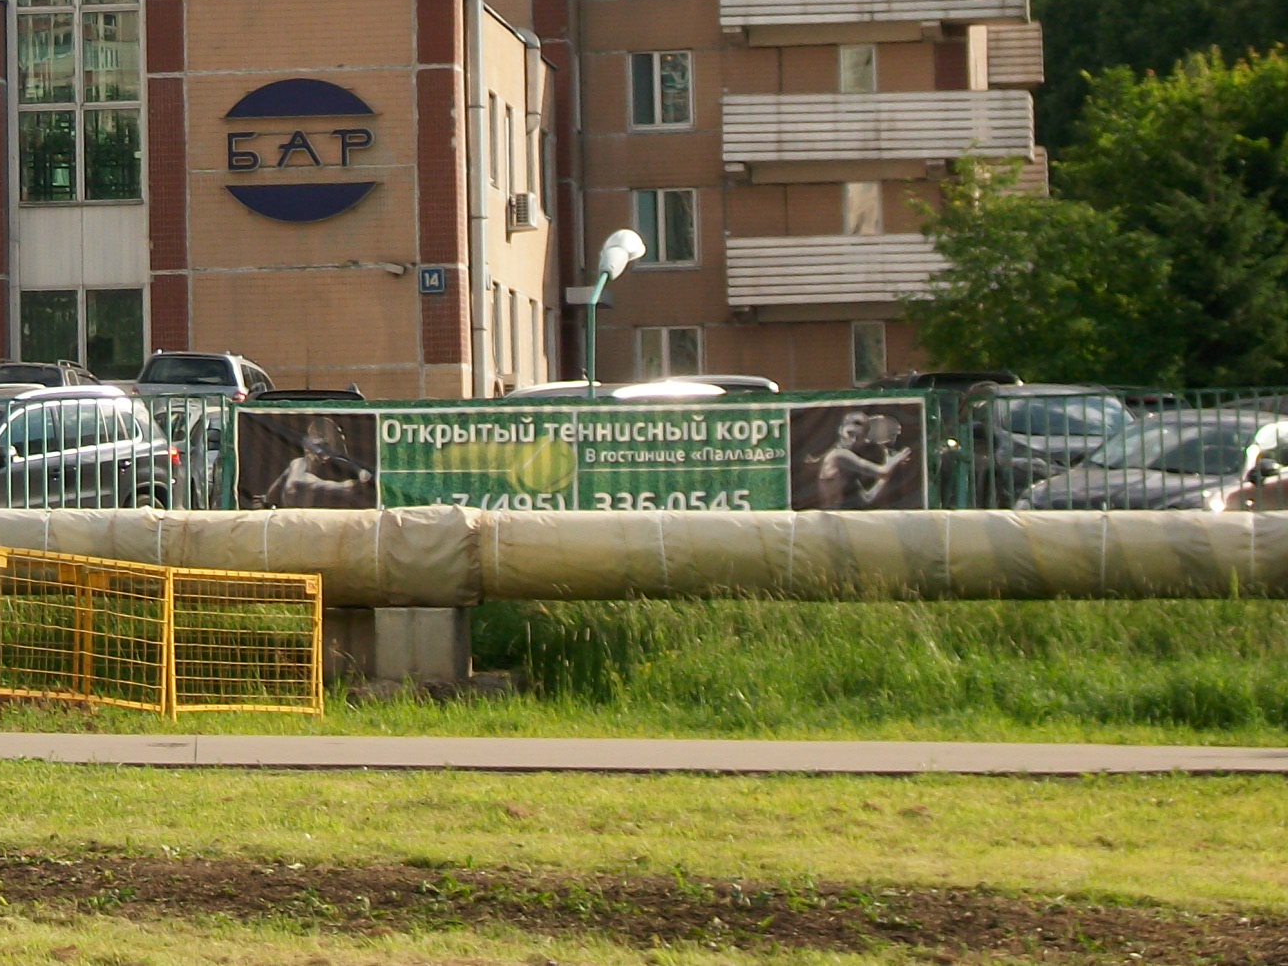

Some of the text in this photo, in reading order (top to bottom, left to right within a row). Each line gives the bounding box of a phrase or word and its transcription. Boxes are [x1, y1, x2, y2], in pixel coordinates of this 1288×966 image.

[226, 128, 375, 172] БАР
[423, 272, 440, 287] 14
[381, 414, 785, 449] Открытый теннисный корт
[585, 446, 786, 464] В гостинице «Паллада»
[480, 492, 567, 511] (495)
